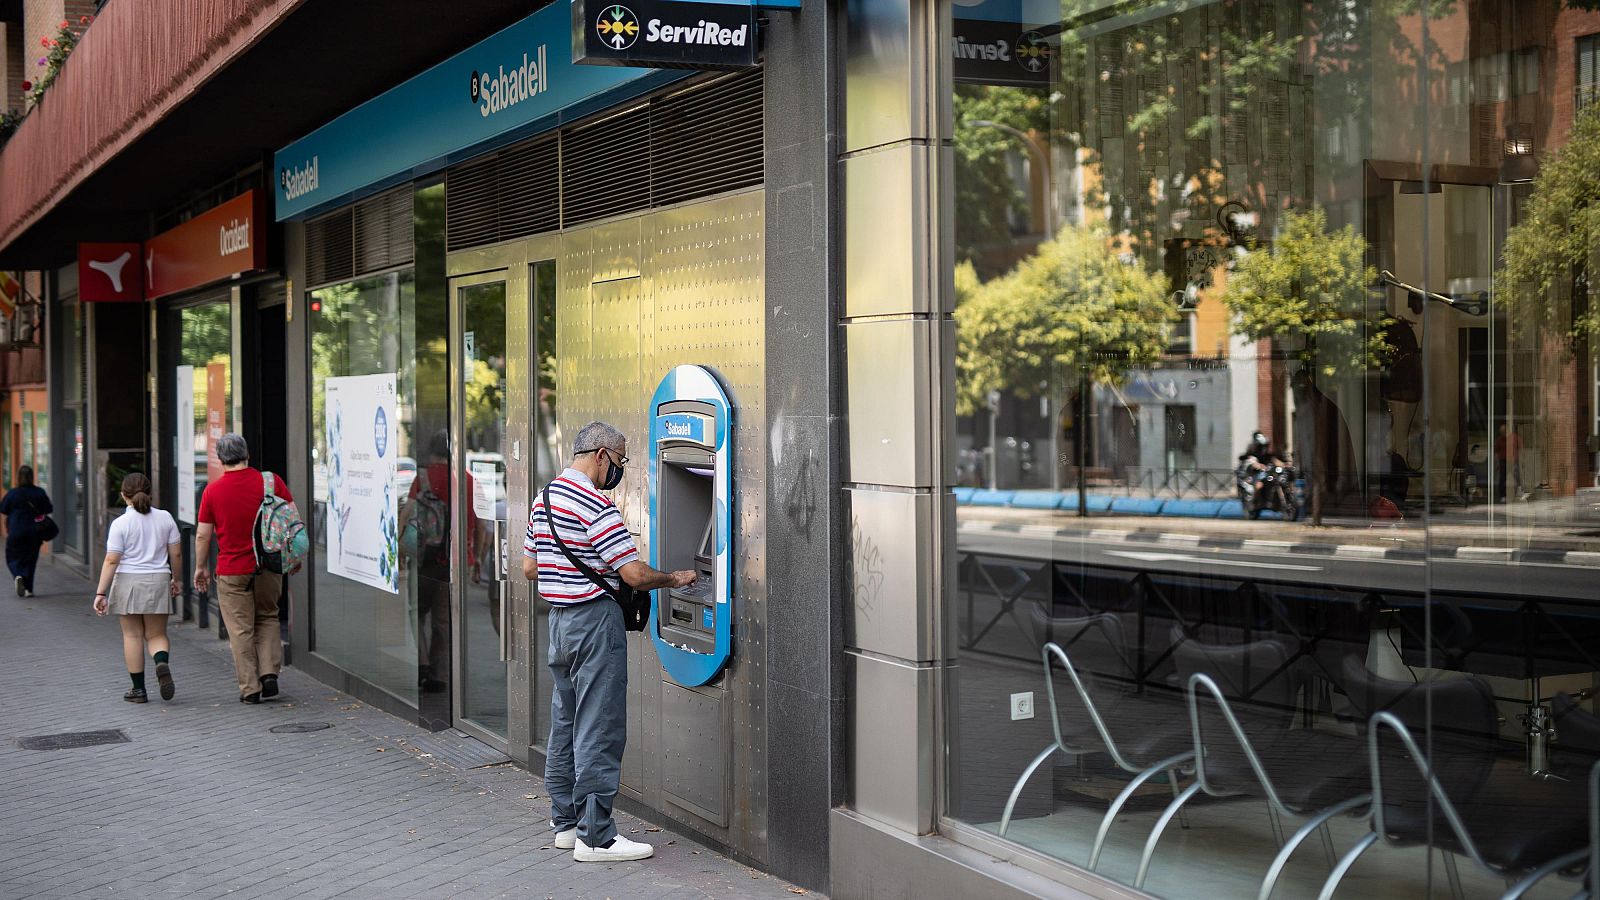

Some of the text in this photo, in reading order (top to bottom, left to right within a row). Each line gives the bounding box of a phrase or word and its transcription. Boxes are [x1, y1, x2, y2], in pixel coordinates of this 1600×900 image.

[646, 18, 748, 47] ServiRed
[480, 43, 547, 118] Sabadell
[285, 155, 319, 201] Sabadell
[220, 217, 249, 257] Occident
[668, 422, 691, 436] Sabadell
